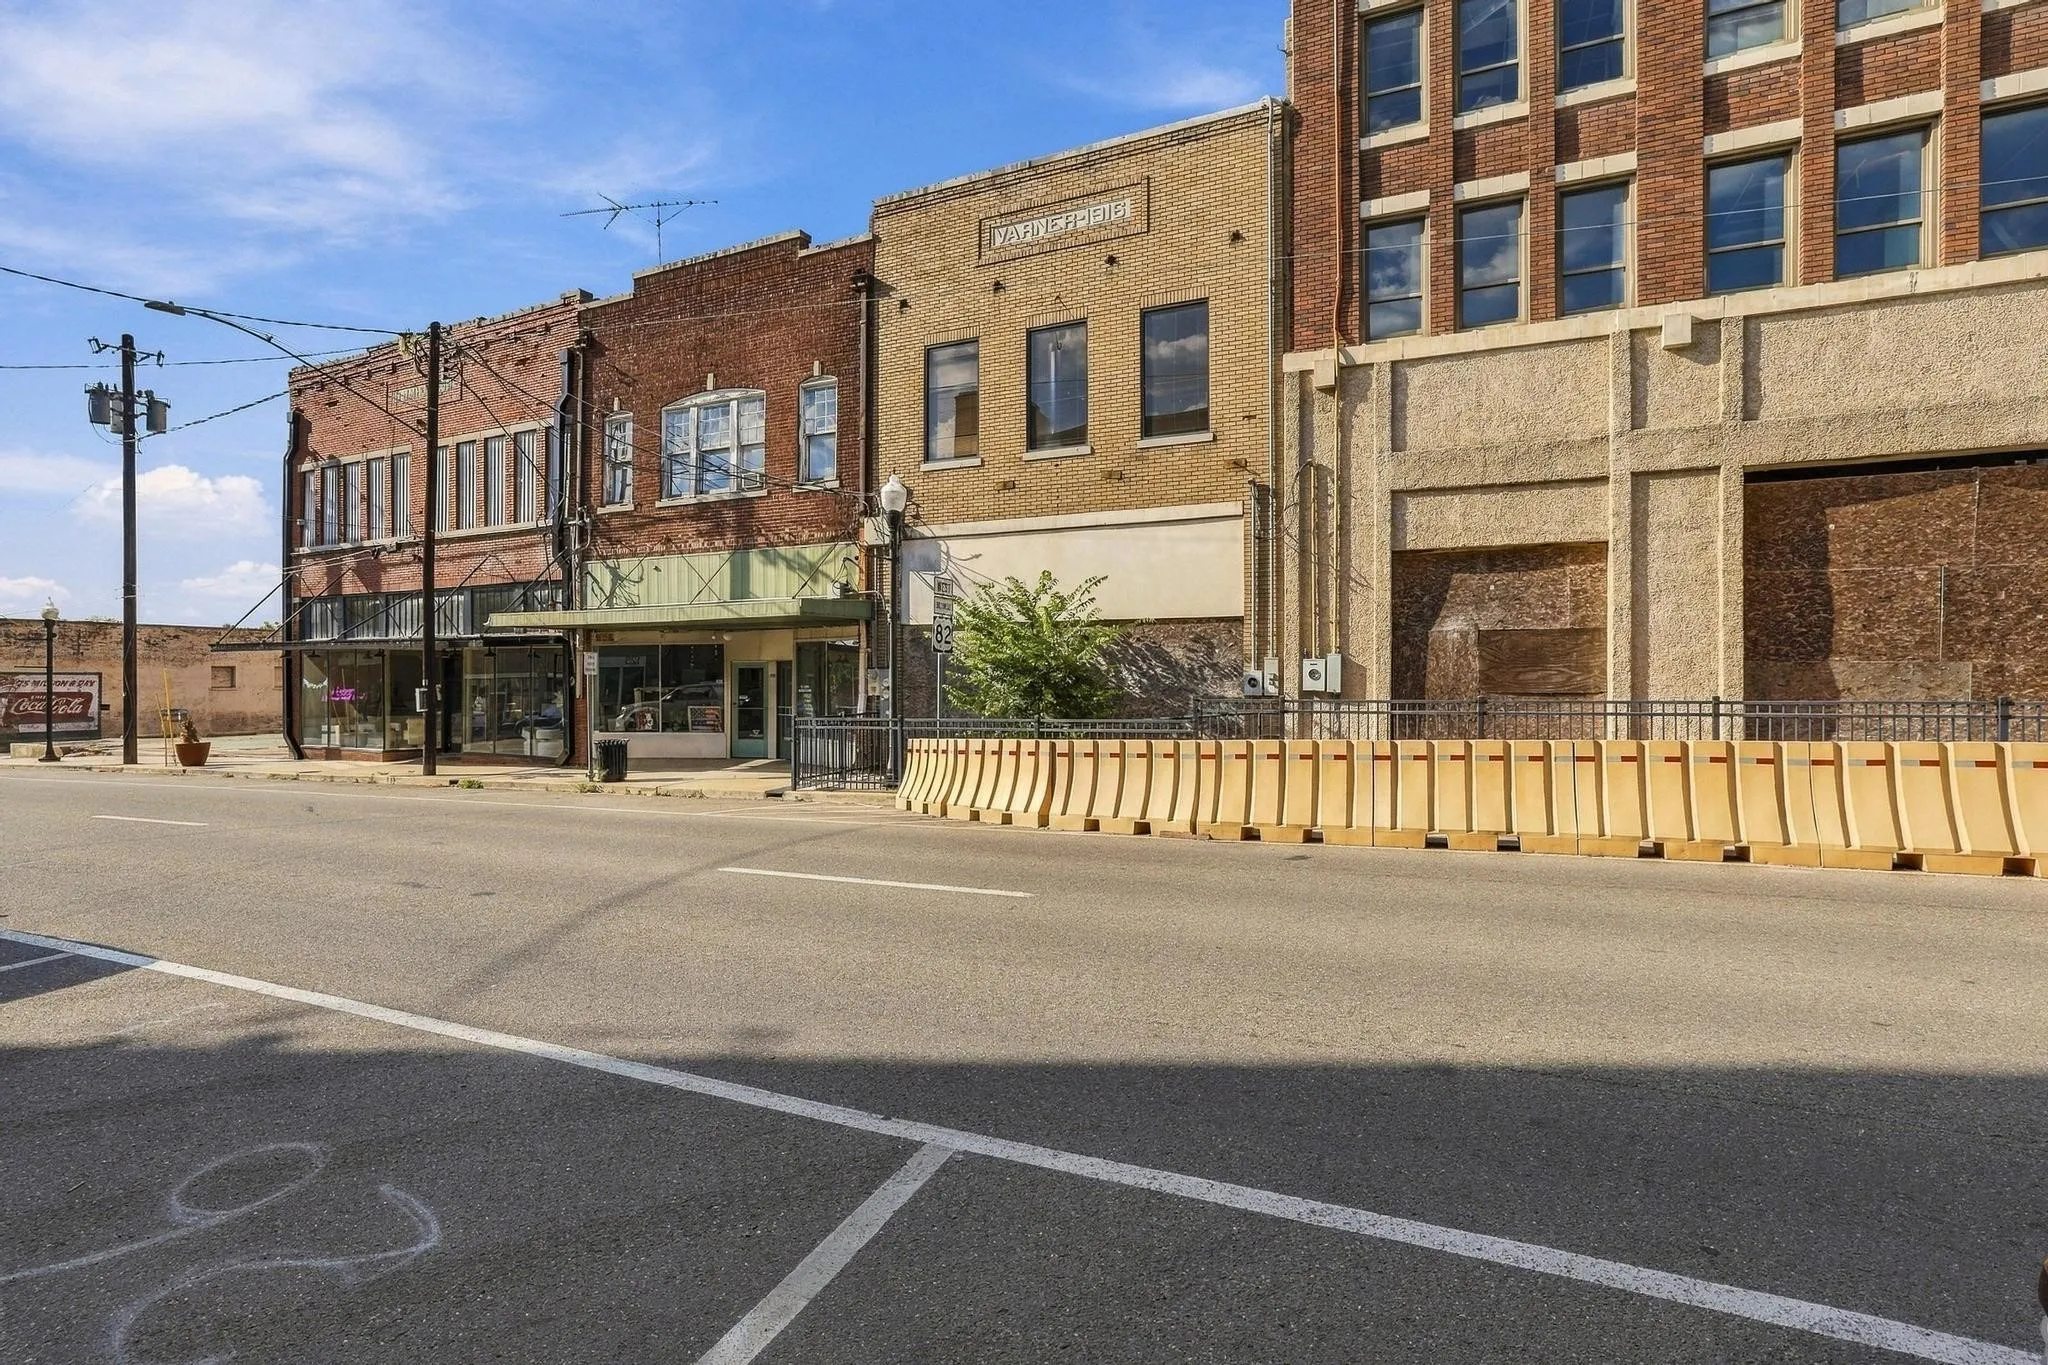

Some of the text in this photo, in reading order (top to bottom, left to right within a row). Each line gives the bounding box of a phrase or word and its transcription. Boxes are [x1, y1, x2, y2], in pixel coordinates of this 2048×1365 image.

[935, 624, 951, 645] 82
[33, 679, 67, 688] MILION
[9, 697, 84, 714] CocaCola
